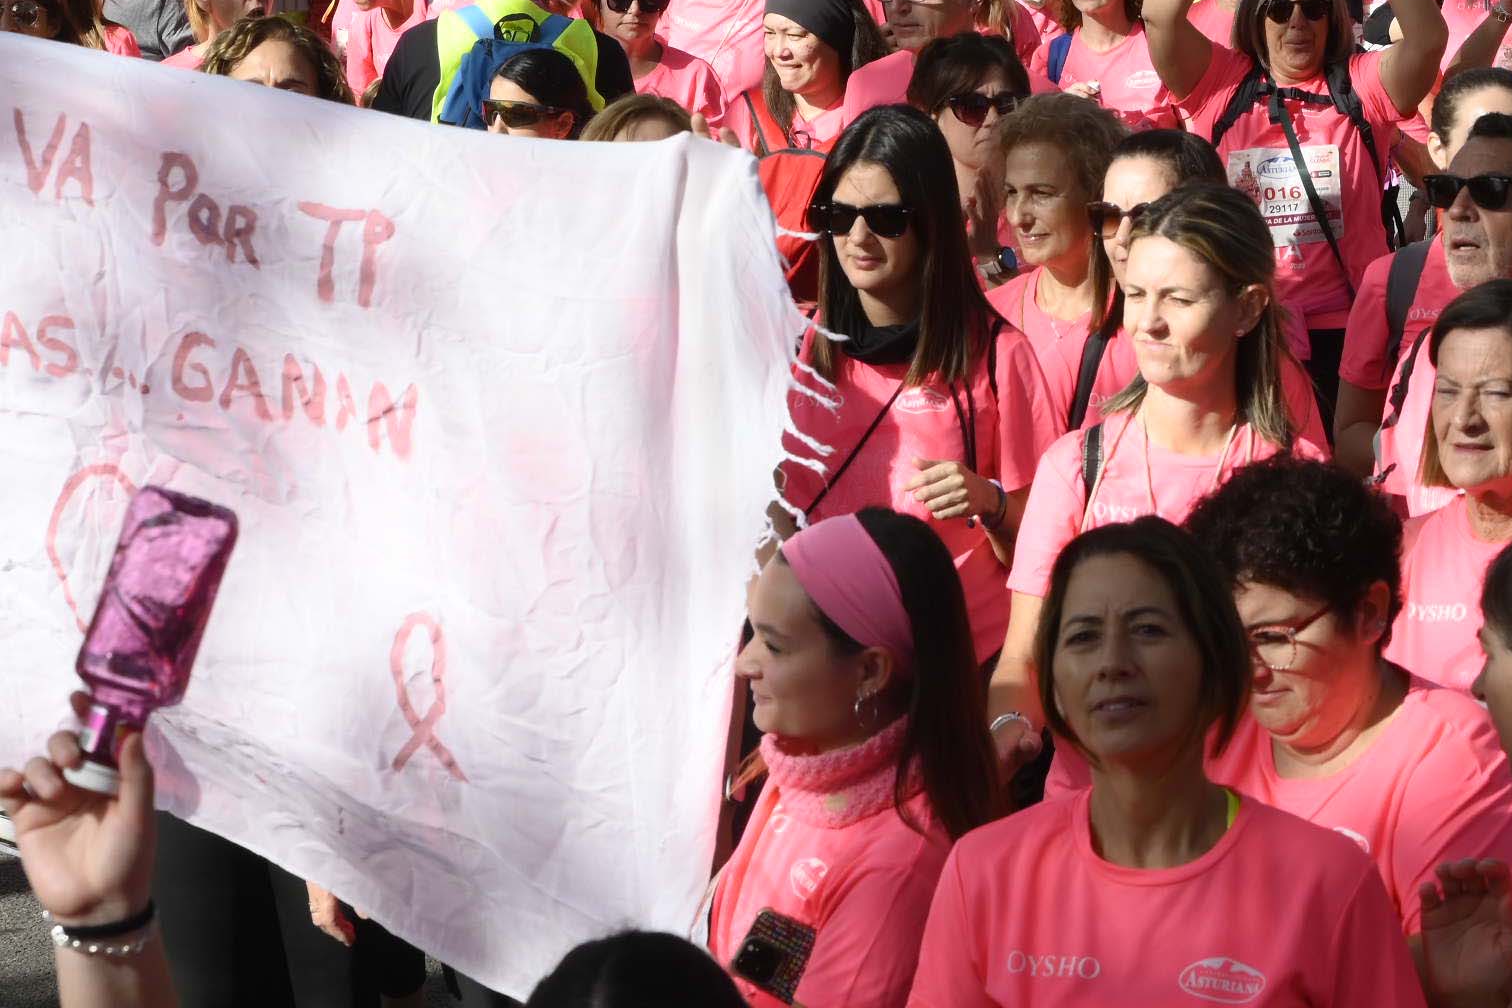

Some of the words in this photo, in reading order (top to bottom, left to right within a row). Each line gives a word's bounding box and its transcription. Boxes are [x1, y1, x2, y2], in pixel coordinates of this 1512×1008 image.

[13, 107, 95, 207] VA
[1264, 186, 1302, 200] 016
[1269, 203, 1299, 214] 29117
[1006, 949, 1101, 980] OYSHO
[1185, 971, 1260, 994] ASTURIANA
